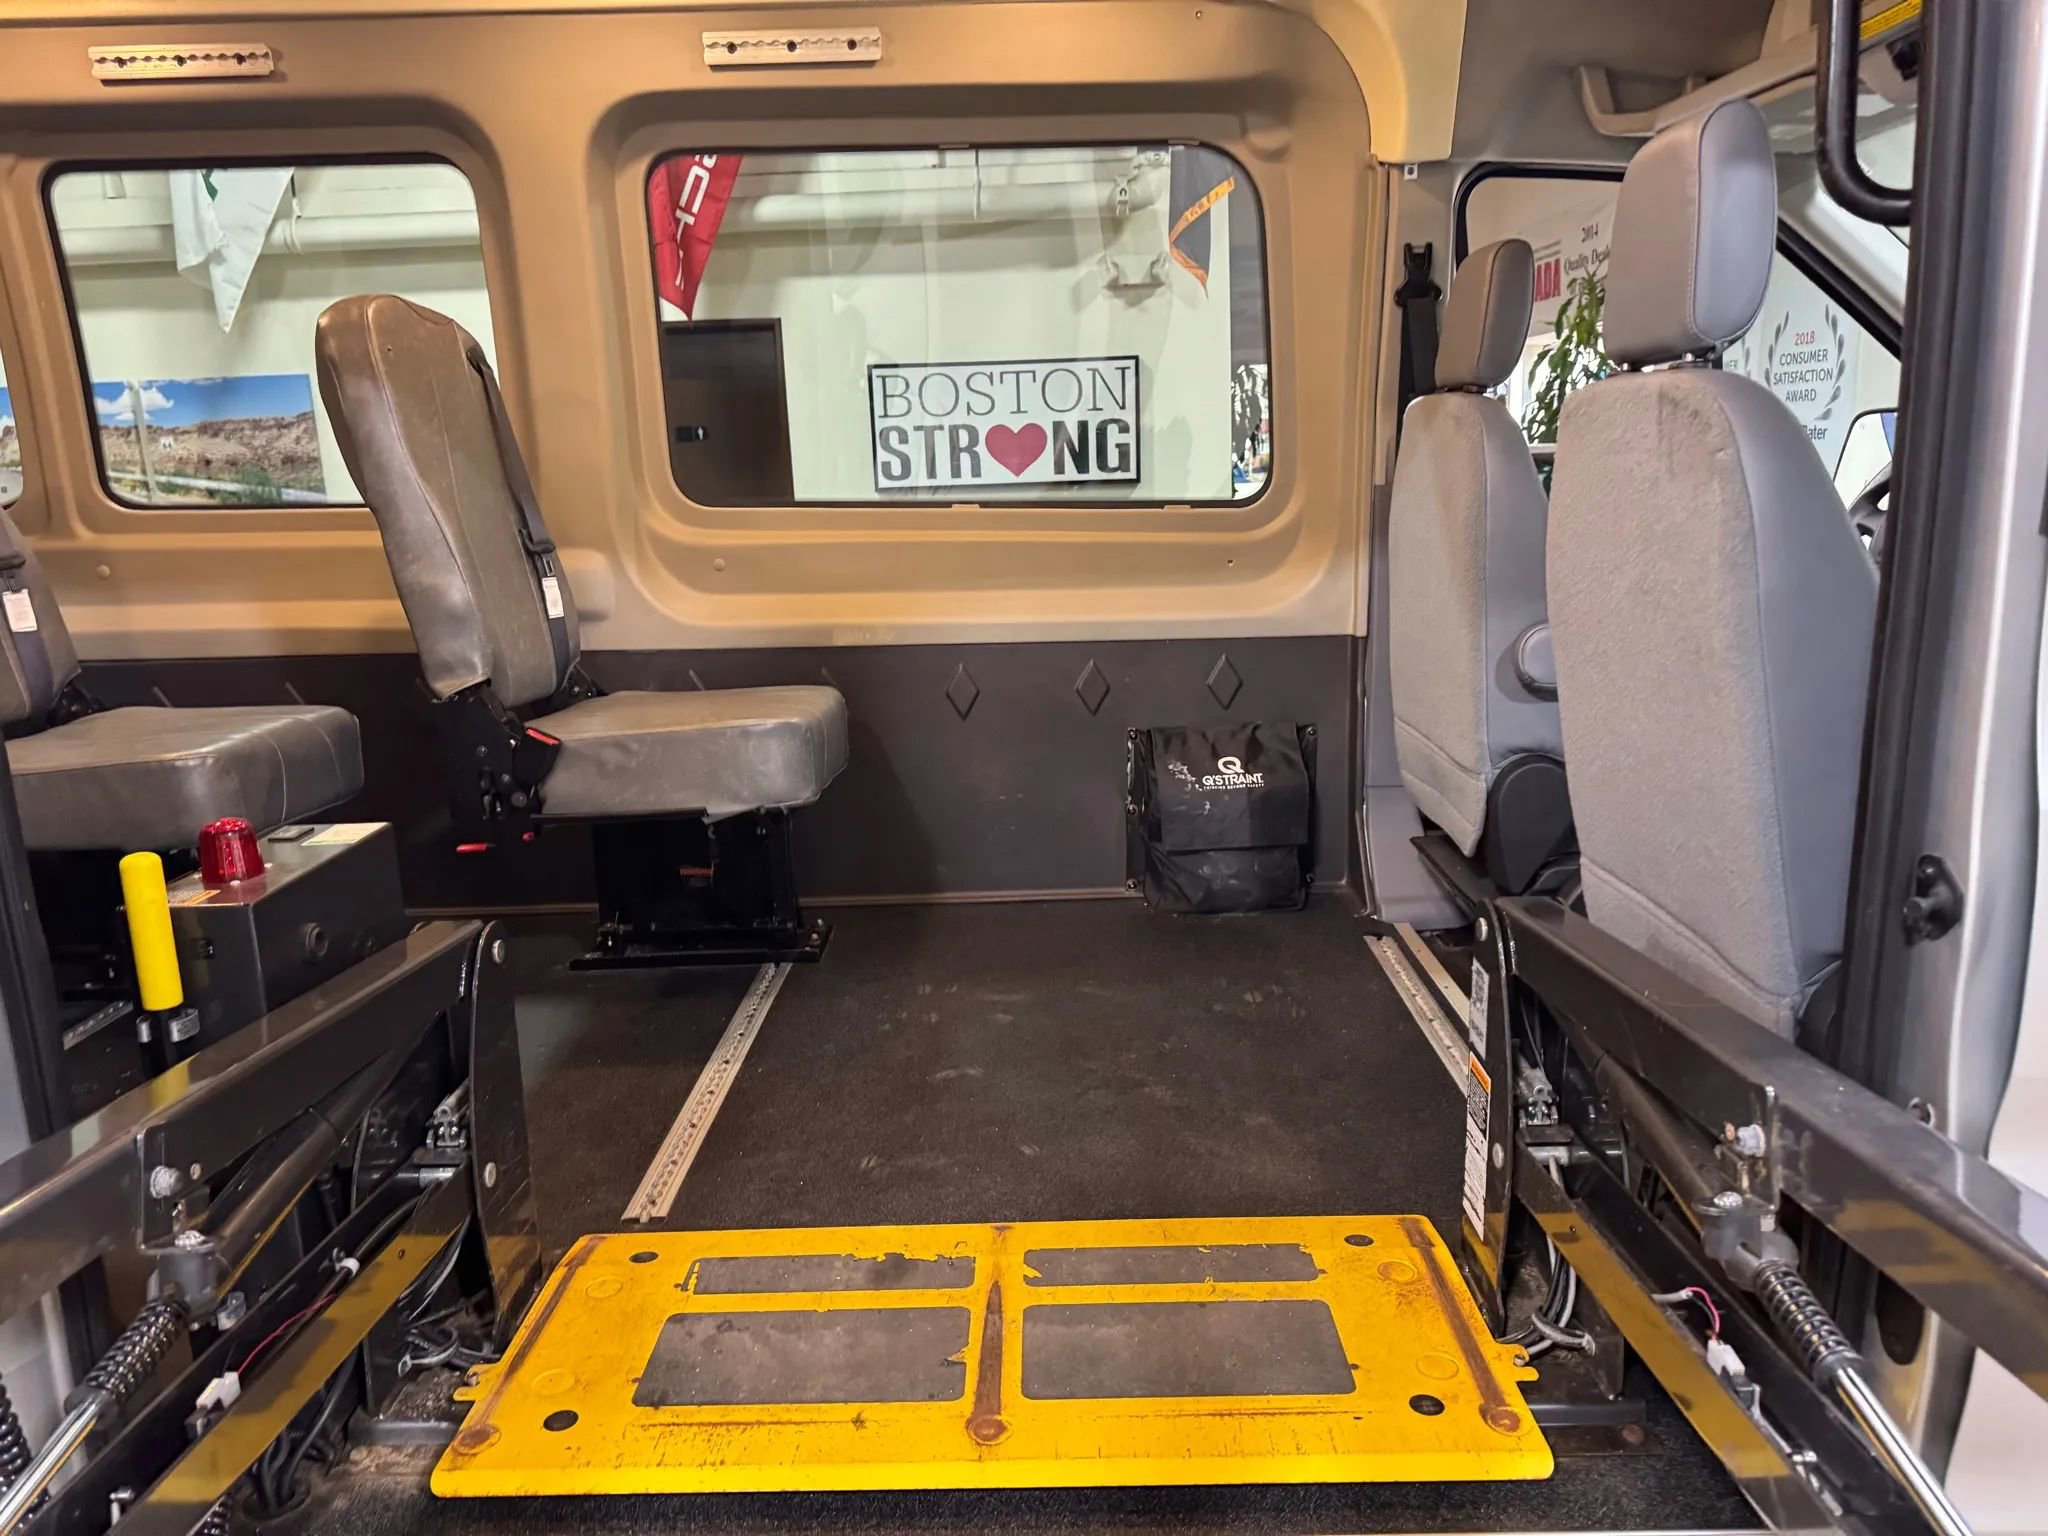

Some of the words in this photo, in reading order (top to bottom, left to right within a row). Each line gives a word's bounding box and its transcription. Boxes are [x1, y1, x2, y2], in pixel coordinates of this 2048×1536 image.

[1795, 330, 1816, 346] 2018
[1779, 348, 1829, 367] CONSUMER
[1773, 367, 1834, 386] SATISFACTION
[876, 366, 1131, 418] BOSTON
[1785, 388, 1817, 403] AWARD
[879, 417, 1131, 482] STRNG
[1217, 756, 1245, 774] Q
